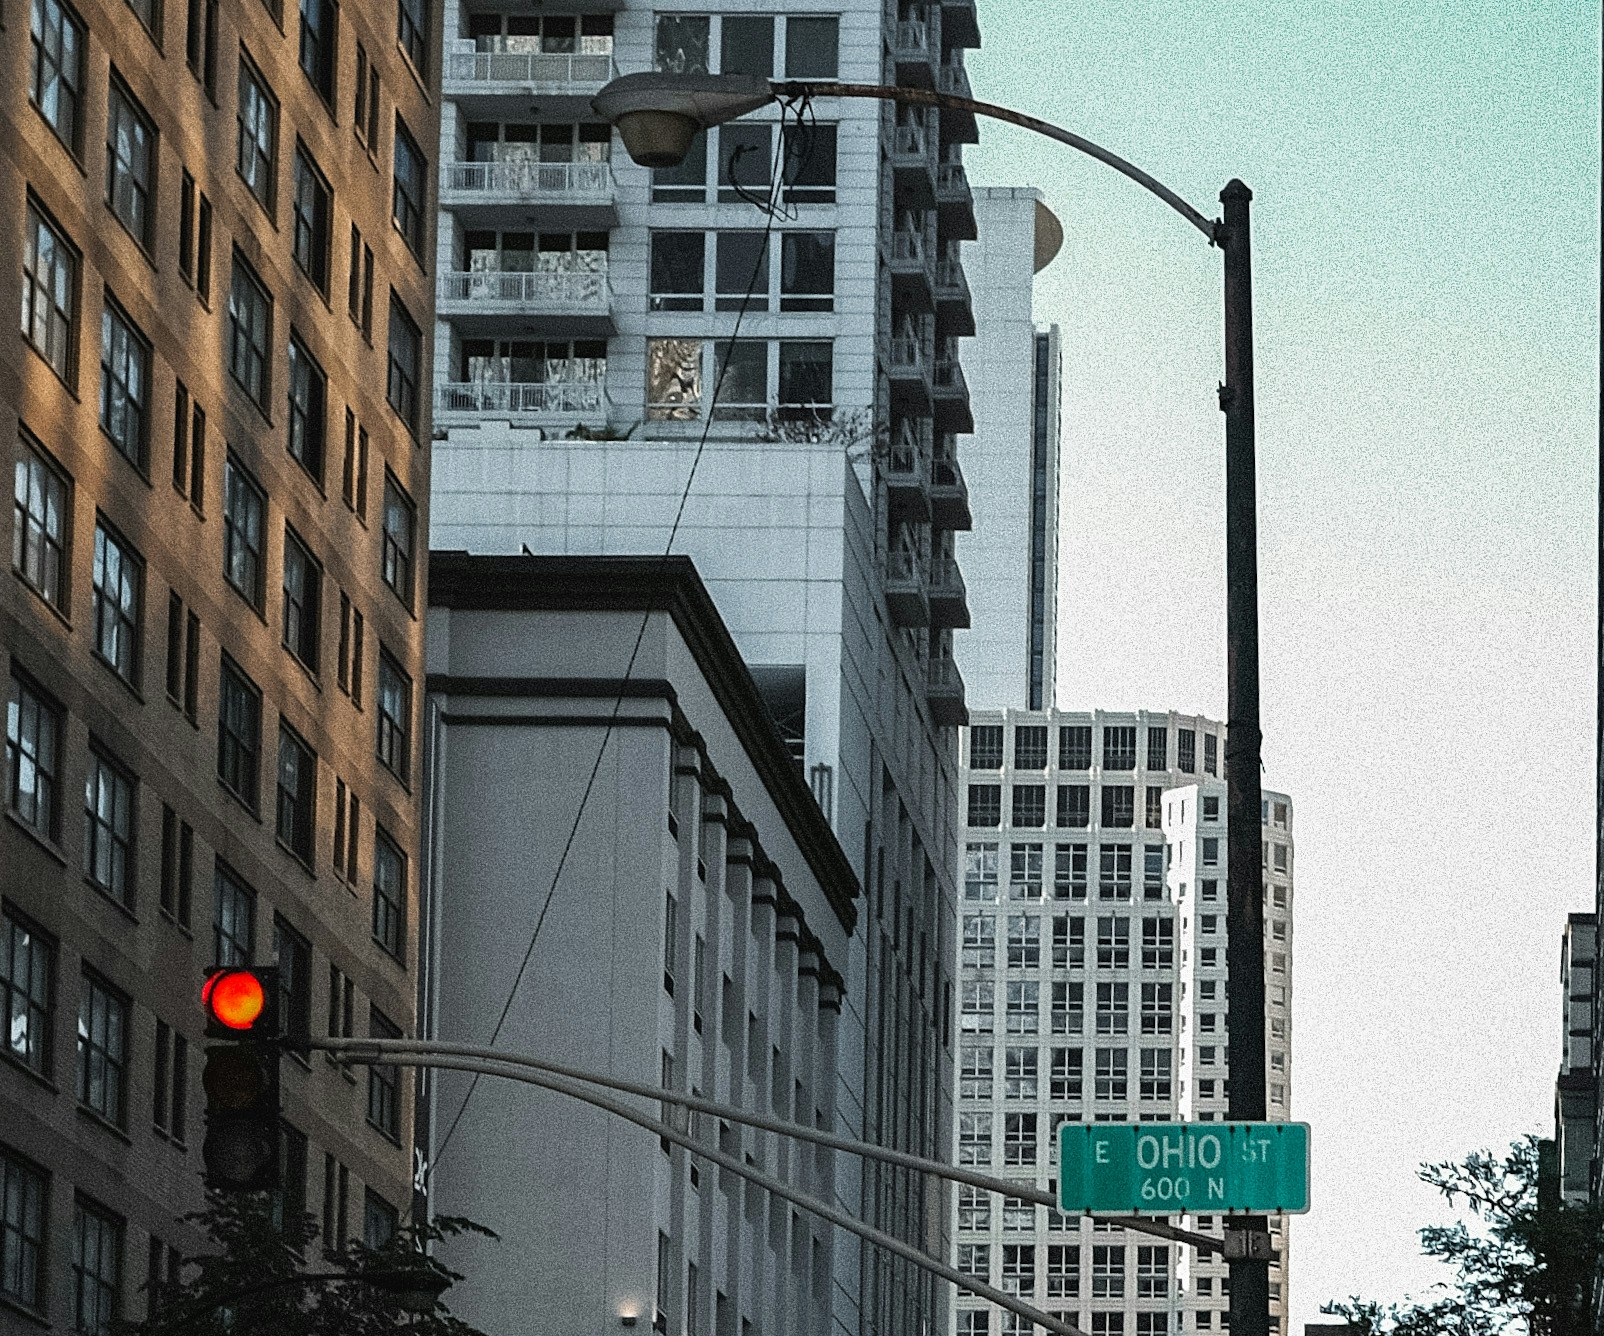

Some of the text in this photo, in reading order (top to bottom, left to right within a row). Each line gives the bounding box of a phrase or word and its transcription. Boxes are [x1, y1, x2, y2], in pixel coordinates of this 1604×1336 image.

[1095, 1134, 1271, 1169] E OHIO ST
[1141, 1177, 1224, 1201] 600 N
